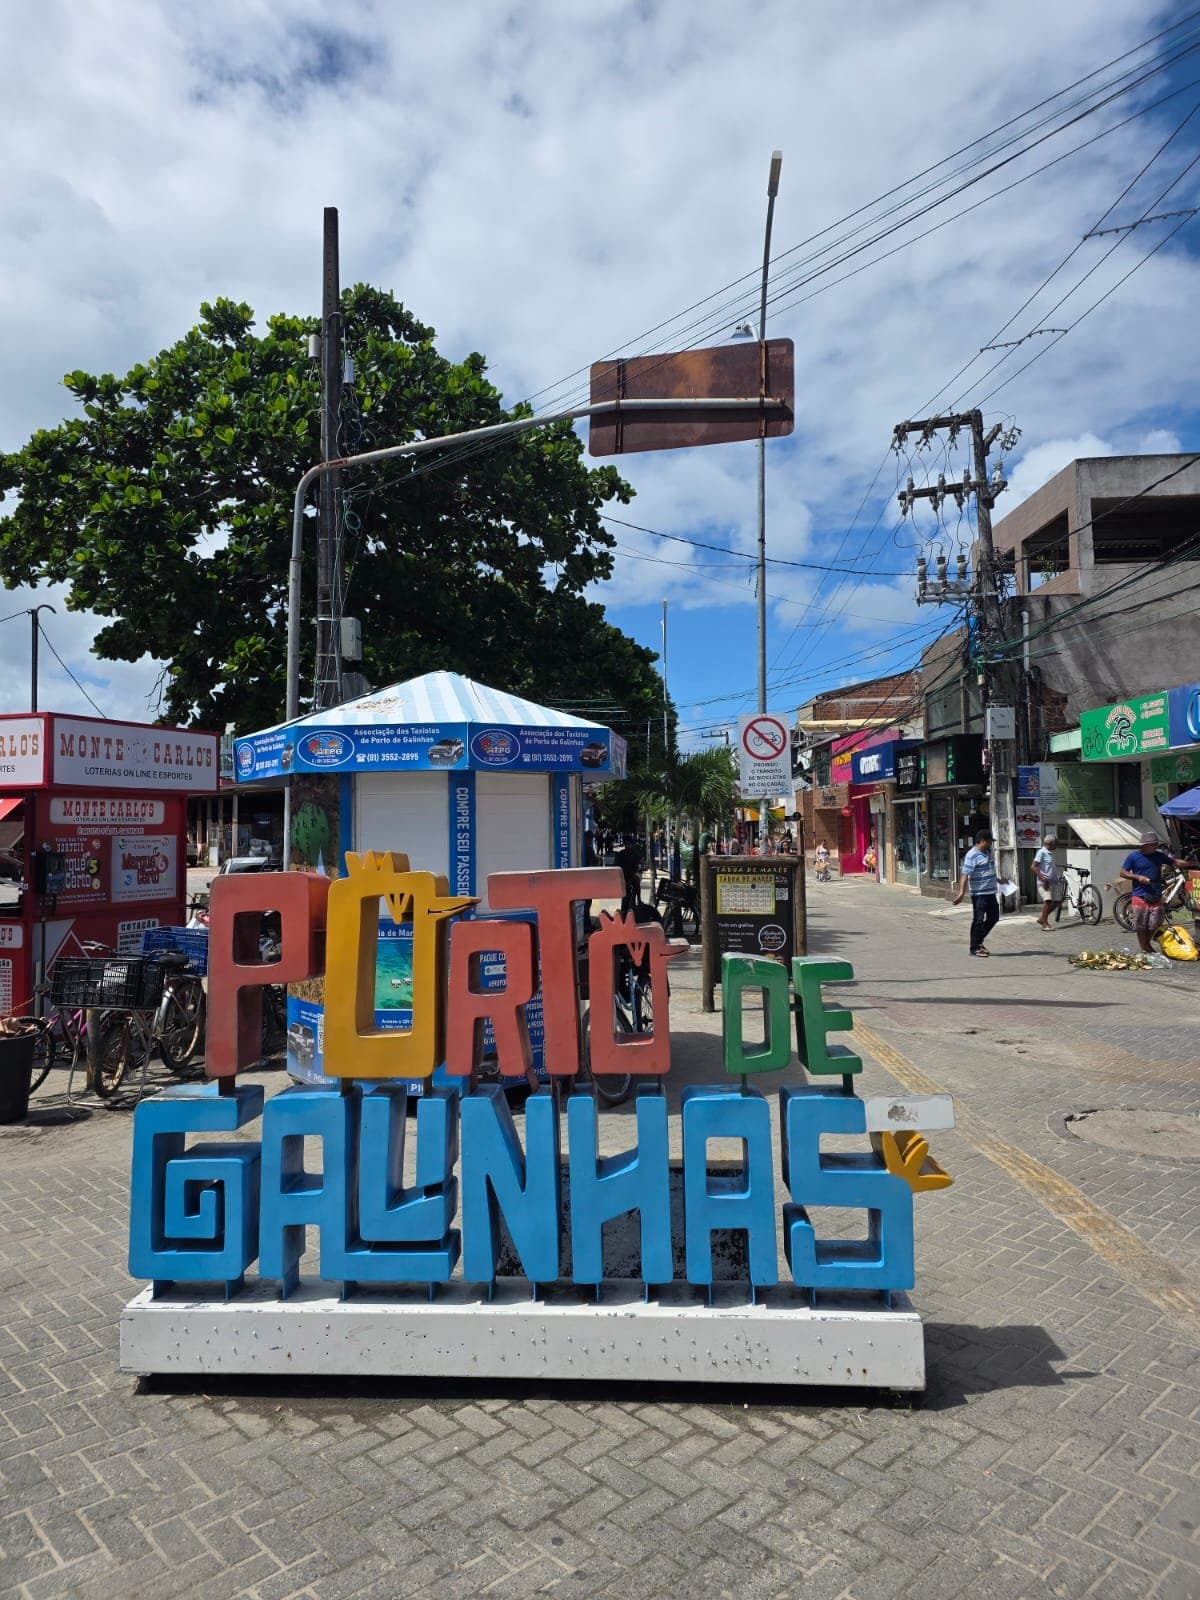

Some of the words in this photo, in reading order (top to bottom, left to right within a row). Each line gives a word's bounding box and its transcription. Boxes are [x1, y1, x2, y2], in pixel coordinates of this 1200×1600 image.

[354, 728, 394, 737] Associação
[411, 727, 440, 735] Taxistas
[370, 736, 392, 745] Porto
[60, 733, 124, 761] MONTE
[153, 742, 212, 768] CARLO'S
[85, 767, 122, 777] LOTERIAS
[123, 769, 134, 778] ON
[136, 770, 151, 778] LINE
[159, 772, 193, 781] ESPORTES
[63, 801, 106, 817] MONTE
[109, 801, 154, 817] CARLO'S
[456, 787, 470, 830] COMPRE
[560, 788, 568, 828] COMPRE
[457, 832, 470, 853] SEU
[560, 830, 568, 848] SEU
[88, 859, 98, 875] 5
[387, 928, 397, 937] de
[206, 852, 684, 1078] PORTO
[723, 953, 864, 1076] DE
[129, 1082, 916, 1291] GALINHAS
